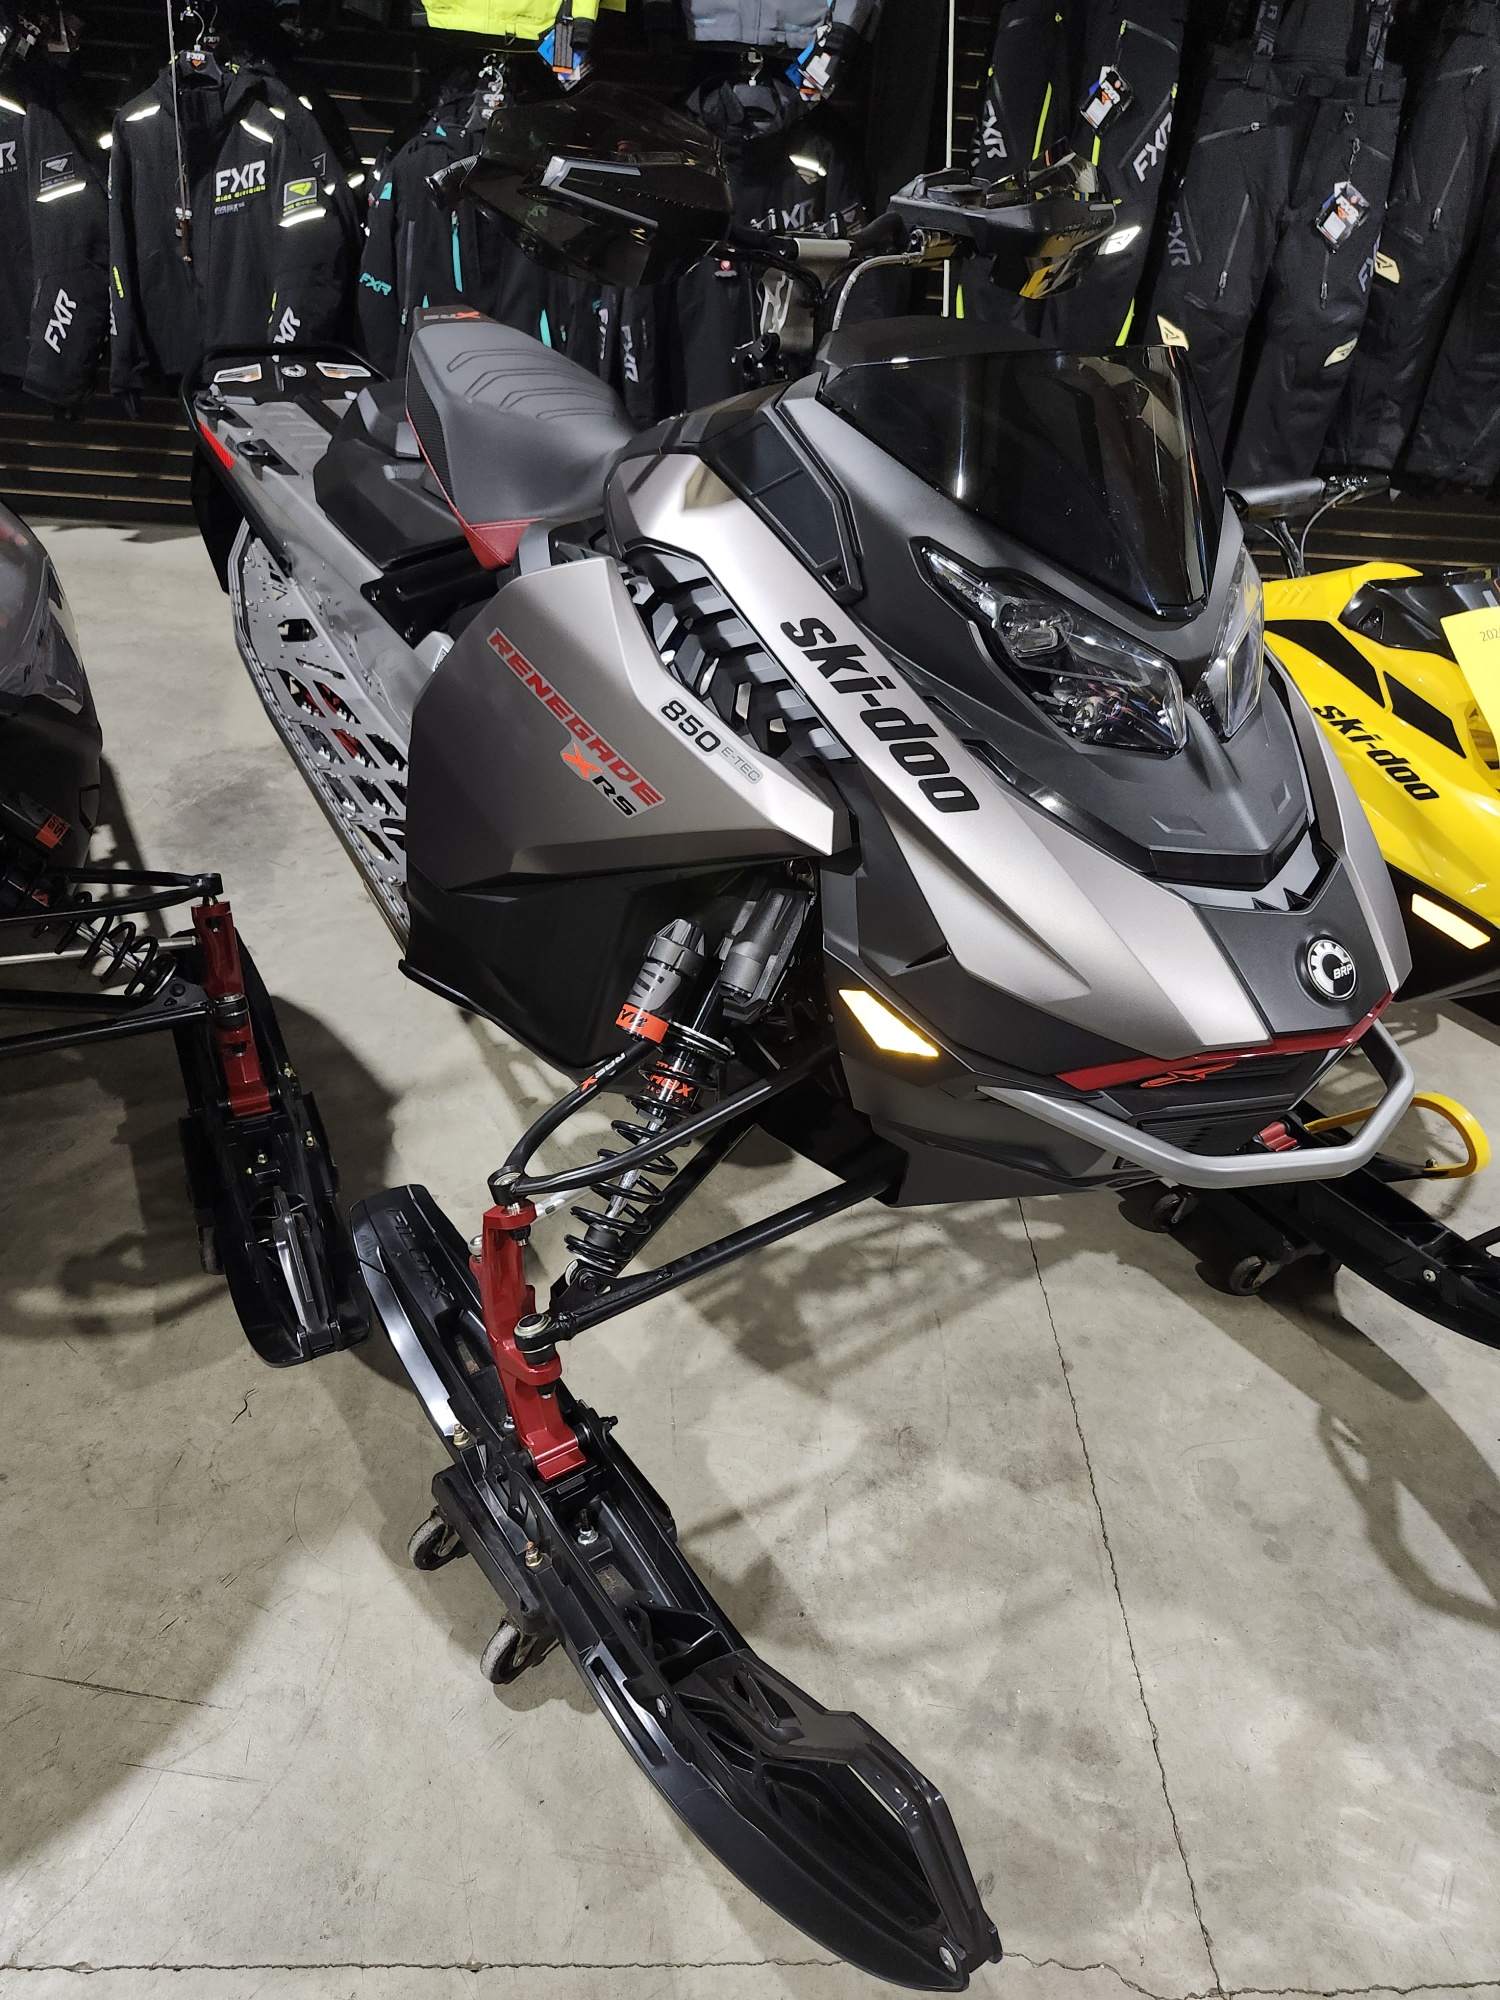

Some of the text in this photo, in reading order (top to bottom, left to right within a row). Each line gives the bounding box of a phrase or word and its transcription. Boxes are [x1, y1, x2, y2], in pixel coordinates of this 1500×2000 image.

[215, 160, 266, 196] FXR
[1168, 211, 1191, 266] FXR
[359, 272, 392, 296] FXR
[44, 288, 77, 354] FXR
[621, 326, 639, 382] FXR
[488, 631, 663, 807] RENEGADE
[661, 700, 760, 781] 850 E-TEC
[562, 742, 604, 779] X
[1333, 963, 1353, 980] BRP
